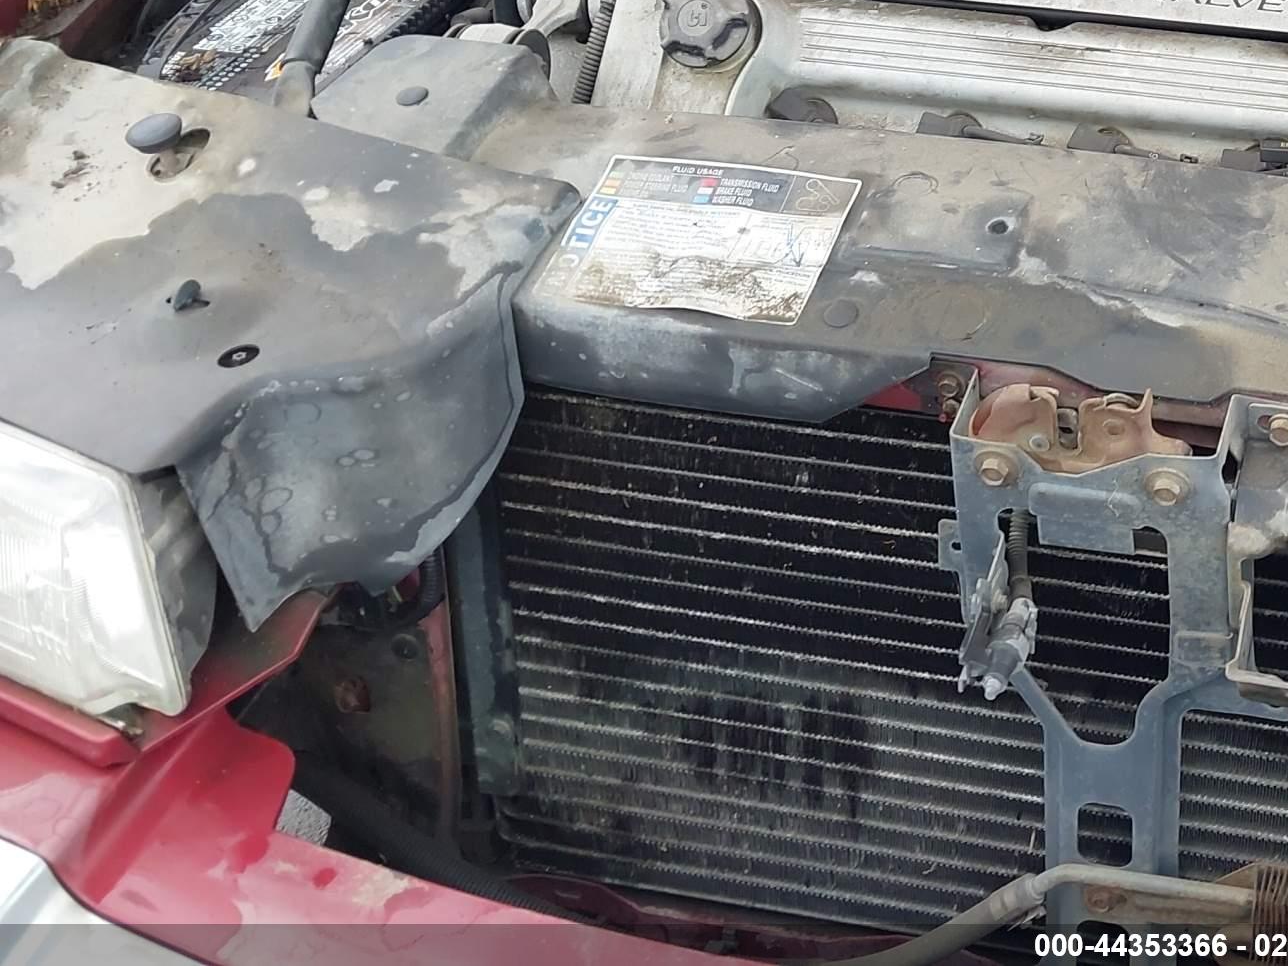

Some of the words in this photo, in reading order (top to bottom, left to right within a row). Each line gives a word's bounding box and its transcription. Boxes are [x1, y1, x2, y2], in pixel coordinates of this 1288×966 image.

[671, 165, 694, 176] FLUID
[695, 166, 725, 177] USAGE
[719, 177, 761, 192] TRANSMISSION
[760, 182, 781, 193] FLUID
[556, 199, 613, 270] OTICE
